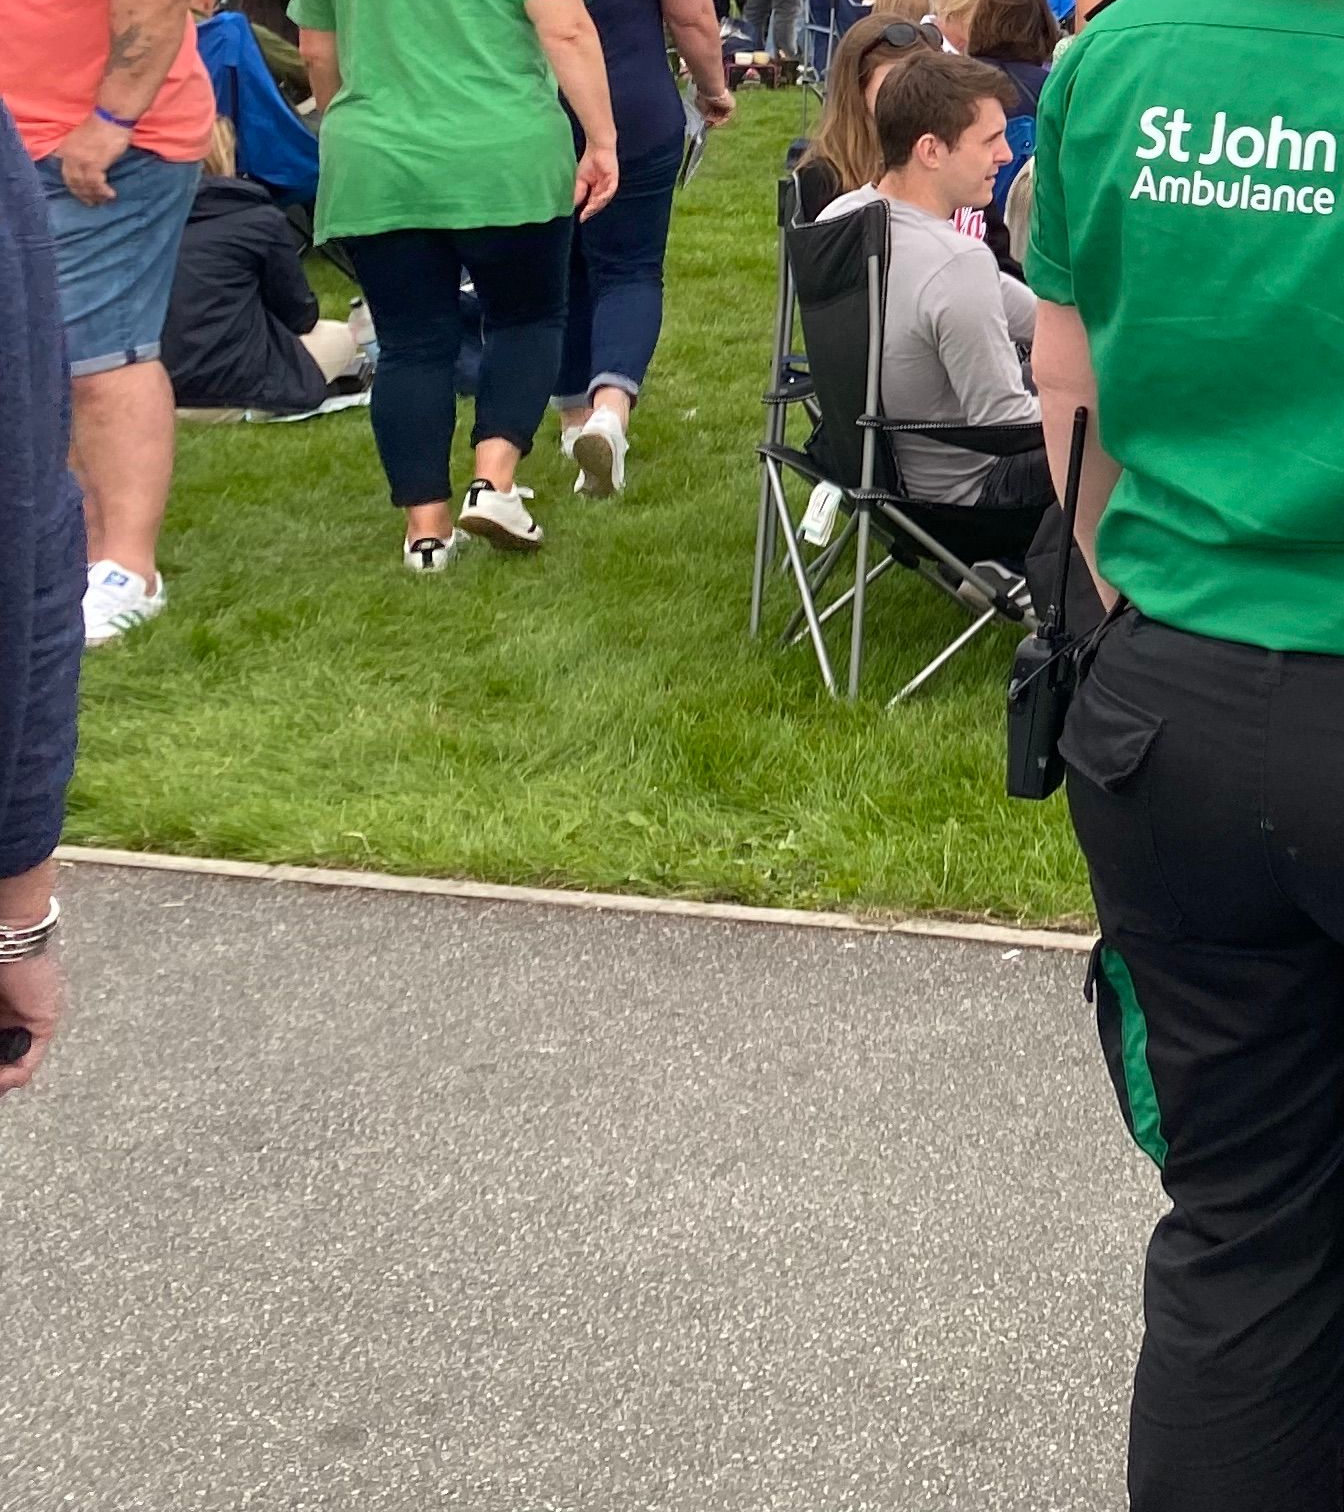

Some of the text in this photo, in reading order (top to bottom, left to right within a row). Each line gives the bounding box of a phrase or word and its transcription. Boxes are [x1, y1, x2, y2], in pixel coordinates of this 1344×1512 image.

[1136, 106, 1337, 173] St John
[1130, 165, 1336, 215] Ambulance
